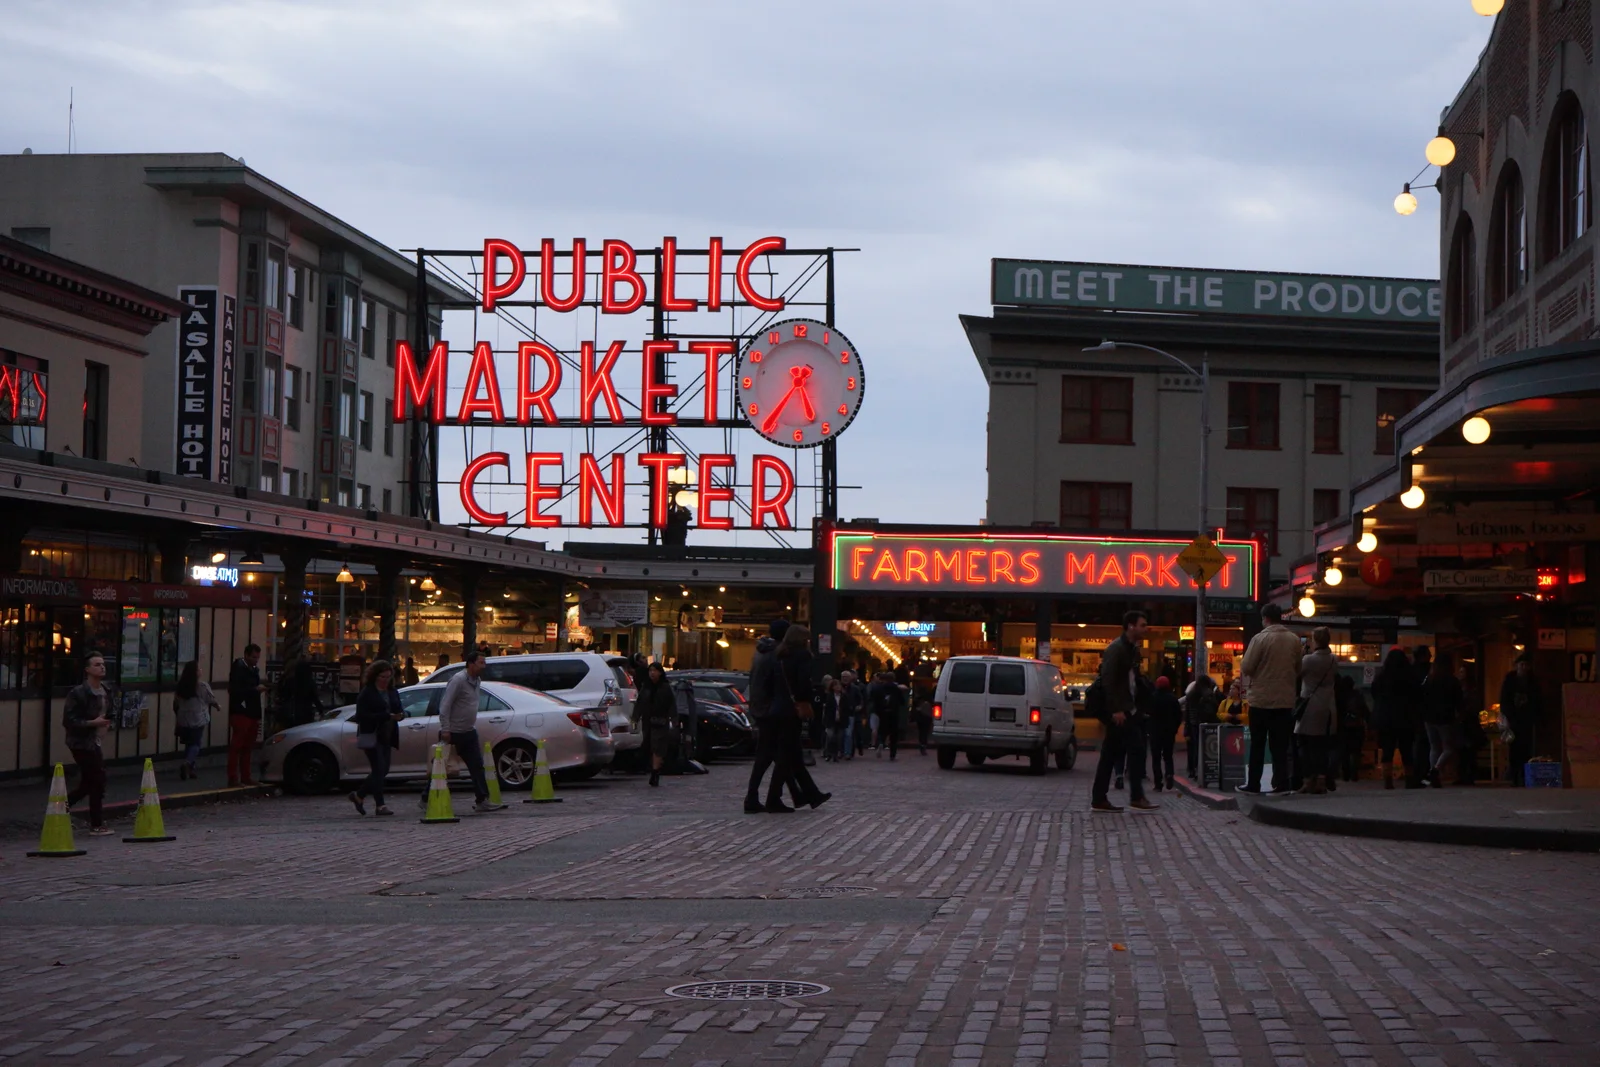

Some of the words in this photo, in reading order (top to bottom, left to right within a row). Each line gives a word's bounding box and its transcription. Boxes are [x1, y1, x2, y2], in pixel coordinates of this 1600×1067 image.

[482, 236, 787, 315] PUBLIC
[1014, 267, 1123, 302] MEET
[1148, 273, 1223, 308] THE
[185, 294, 208, 325] LA
[768, 332, 780, 345] 11
[793, 325, 808, 338] 12
[823, 331, 829, 345] 1
[749, 350, 763, 363] 10
[840, 351, 850, 364] 2
[183, 331, 209, 413] SALLE
[393, 340, 739, 427] MARKET
[742, 377, 752, 390] 9
[846, 376, 856, 391] 3
[748, 402, 759, 416] 8
[837, 403, 848, 416] 4
[793, 429, 803, 442] 6
[821, 422, 831, 435] 5
[181, 424, 205, 479] HOT
[459, 451, 795, 531] CENTER
[1482, 522, 1525, 535] bank
[1531, 521, 1586, 534] books
[217, 567, 232, 581] ATM
[851, 547, 1041, 585] FARMERS
[1066, 551, 1237, 589] MARKT
[1429, 572, 1450, 585] The
[1504, 571, 1534, 586] Shop
[3, 578, 67, 596] INFORMATION
[92, 585, 117, 600] seattle
[153, 589, 189, 599] INFORMATION
